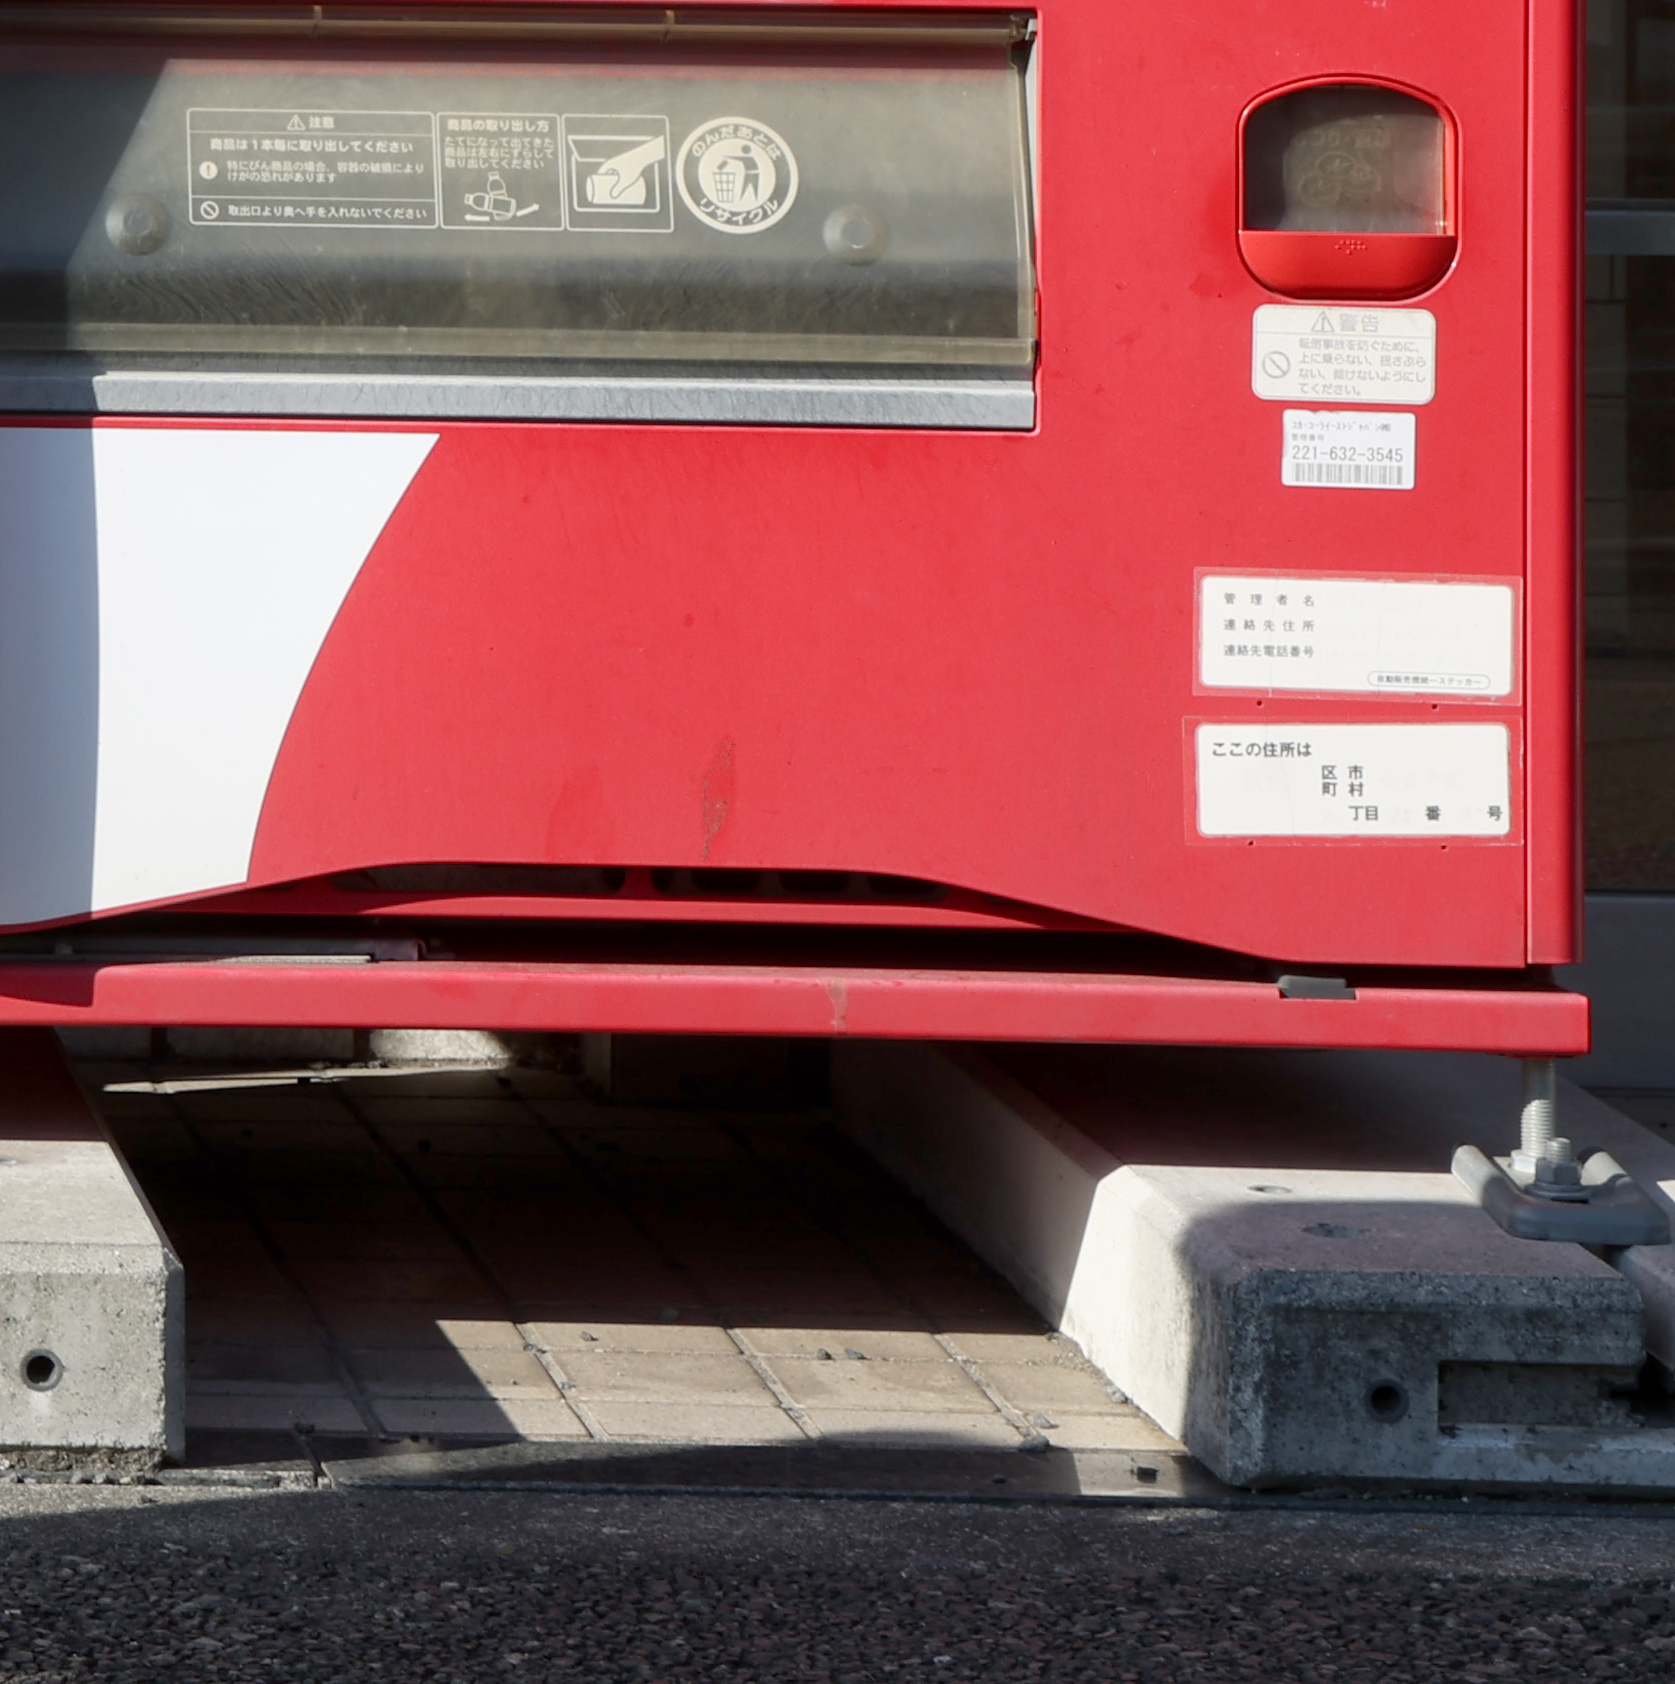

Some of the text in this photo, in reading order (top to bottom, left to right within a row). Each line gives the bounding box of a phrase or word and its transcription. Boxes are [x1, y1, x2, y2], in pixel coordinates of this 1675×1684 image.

[309, 115, 336, 130] 注意
[447, 119, 550, 132] 商品の取り出し方
[444, 136, 555, 149] たてになって出てきた
[692, 125, 783, 162] のんだあとは
[444, 146, 555, 159] 商品は左右にずらして
[444, 157, 546, 169] 取り出してください
[699, 197, 779, 226] リサイクル
[1339, 313, 1381, 333] 警告
[1298, 382, 1361, 396] てください。
[1292, 445, 1403, 463] 221-632-3545
[1223, 644, 1315, 659] 連絡先電話番号
[1212, 741, 1313, 758] ここの住所は
[1321, 764, 1364, 781] 区 市
[1321, 781, 1364, 798] 町 村
[1348, 805, 1504, 821] 丁目 番 号
